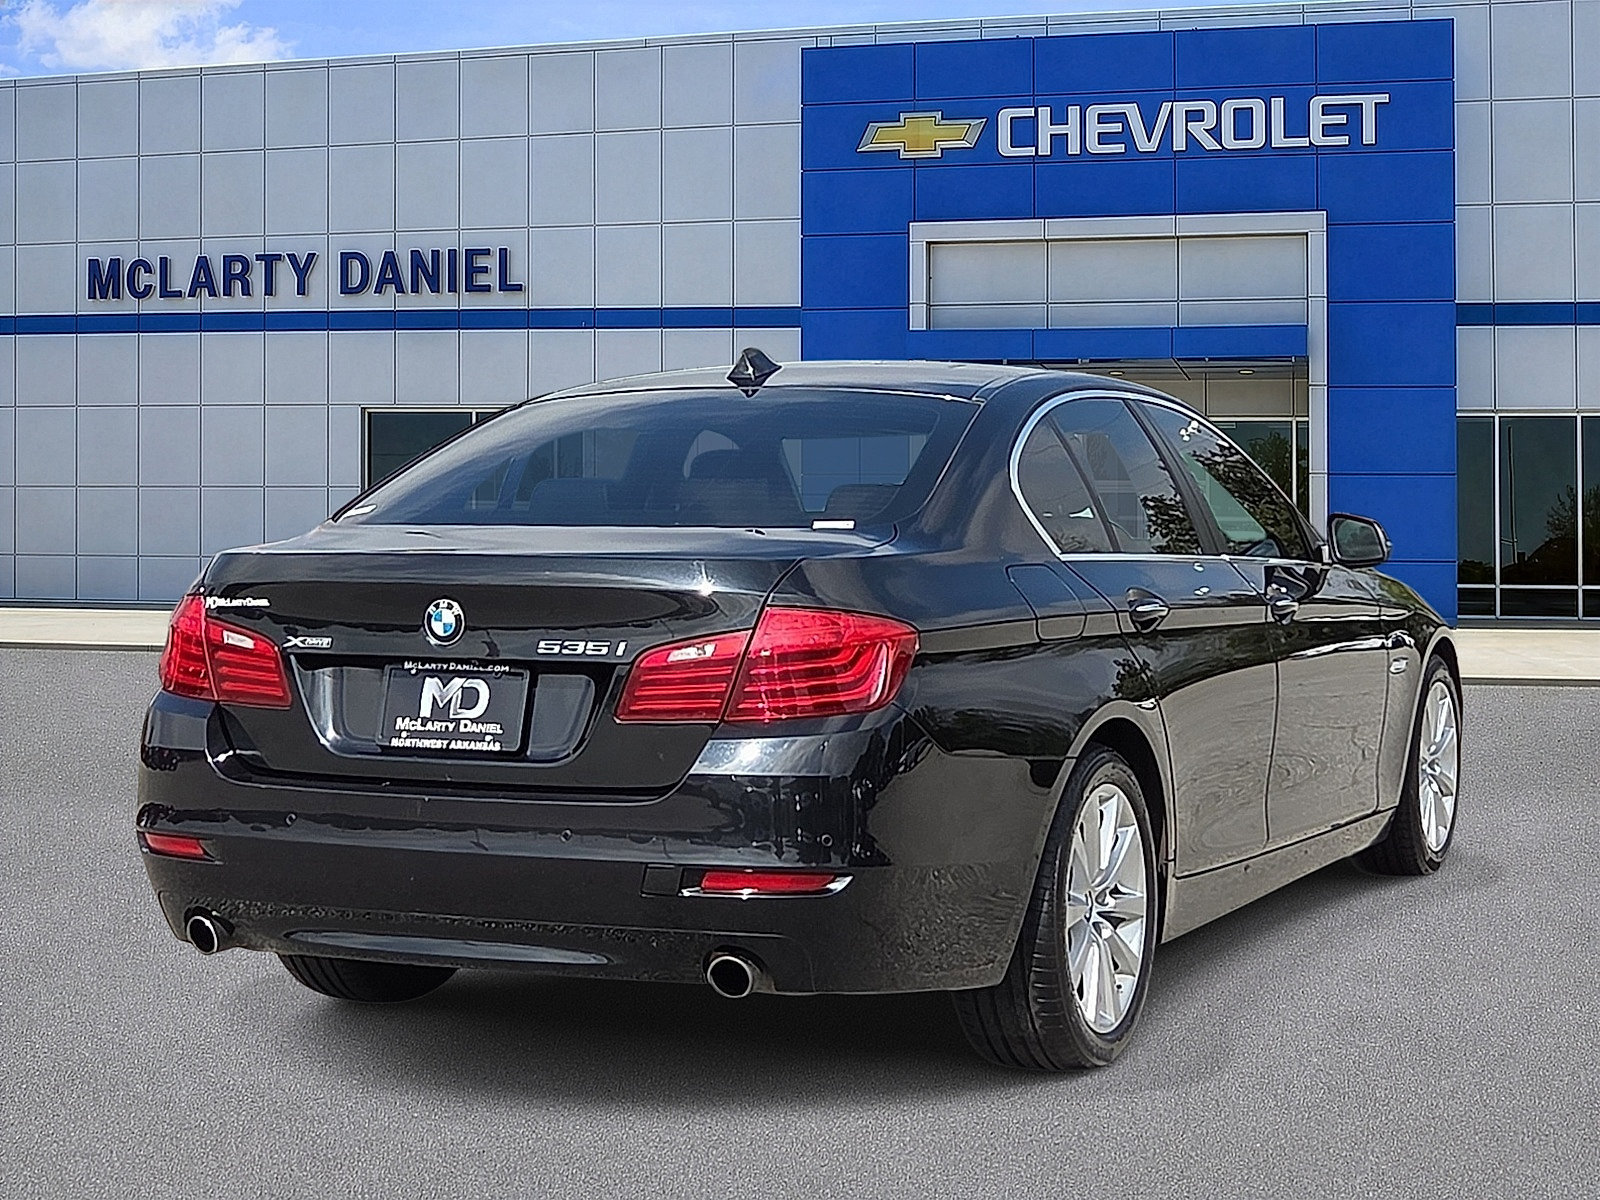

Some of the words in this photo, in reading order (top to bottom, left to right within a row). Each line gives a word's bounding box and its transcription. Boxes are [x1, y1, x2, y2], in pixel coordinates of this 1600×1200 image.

[997, 93, 1391, 158] CHEVROLET
[87, 251, 318, 300] MCLARTY
[338, 246, 526, 297] DANIEL
[419, 676, 491, 719] MD
[459, 719, 504, 734] DANIEL
